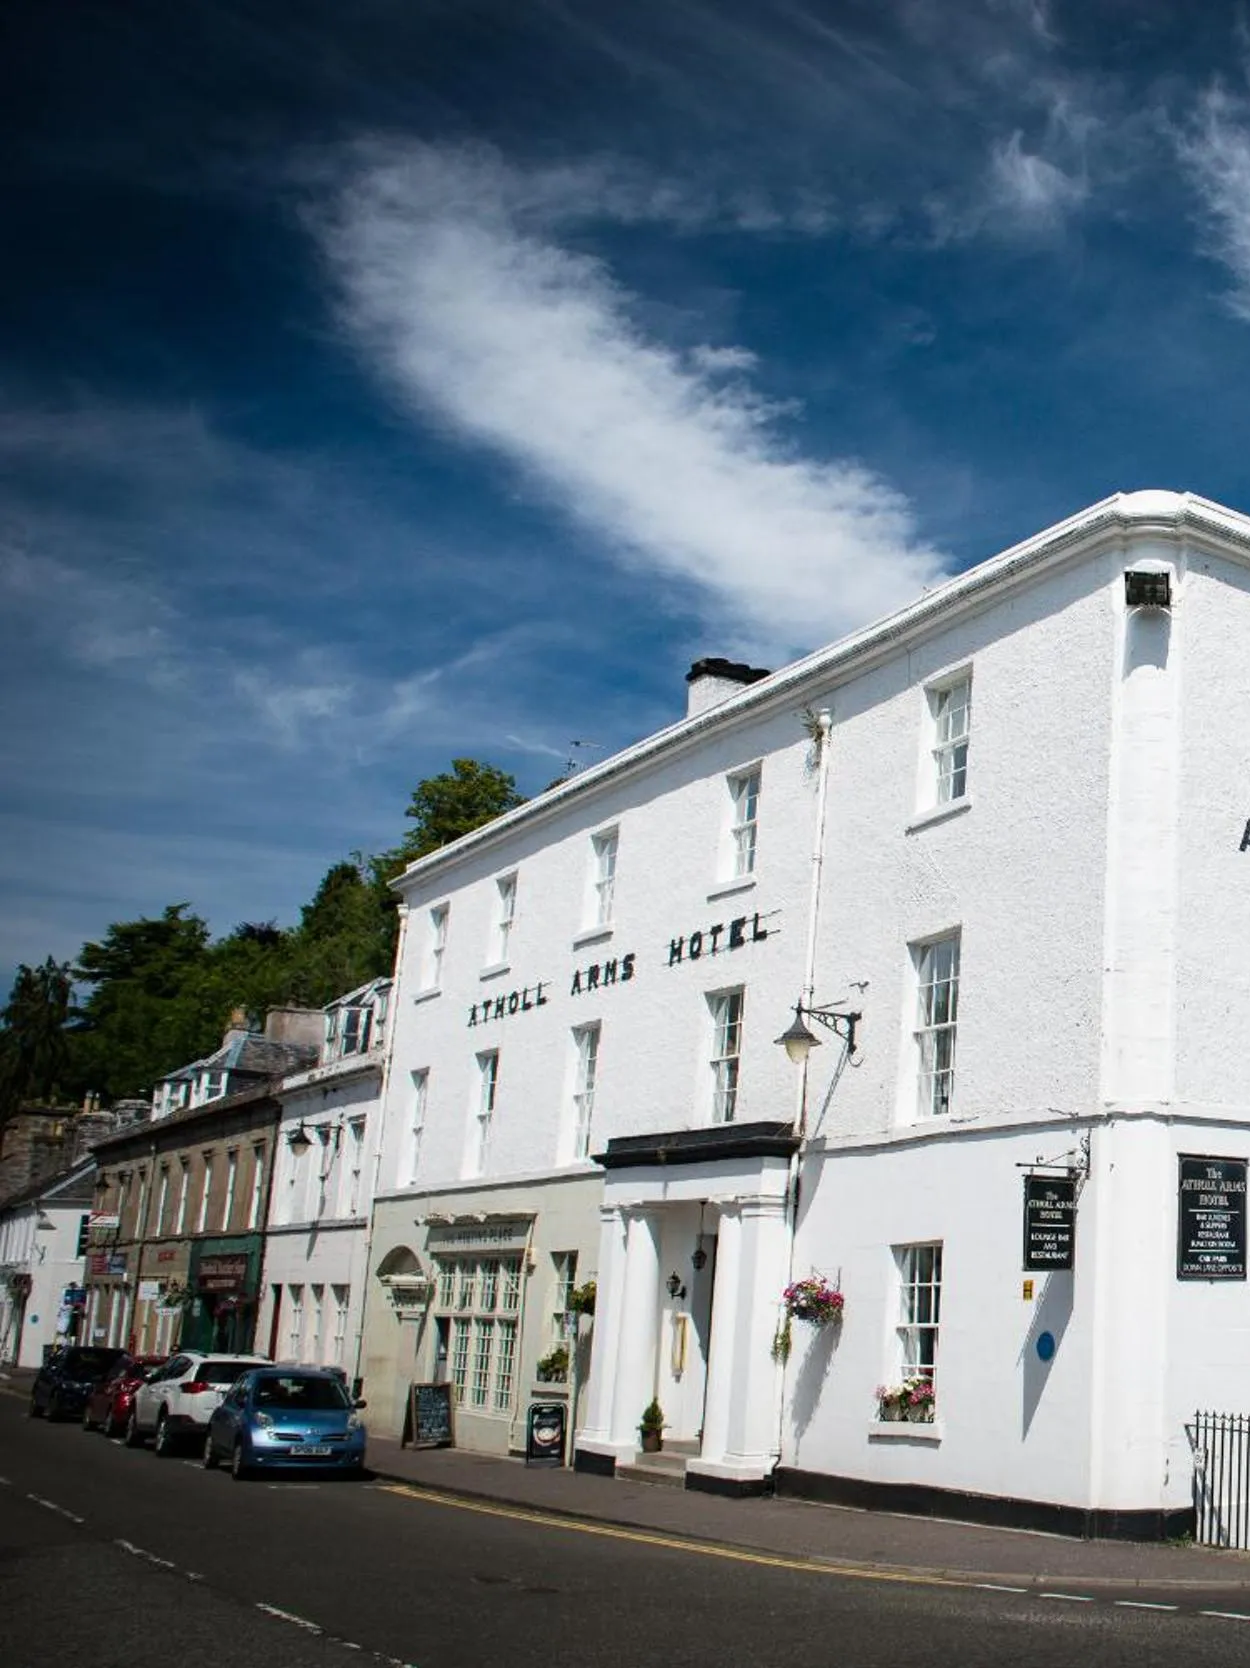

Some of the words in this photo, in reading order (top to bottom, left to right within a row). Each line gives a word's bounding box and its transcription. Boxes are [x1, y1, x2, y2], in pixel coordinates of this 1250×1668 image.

[467, 982, 548, 1027] ATHOLL
[571, 953, 635, 996] ARMS
[669, 912, 767, 967] HOTEL
[1206, 1167, 1222, 1179] The
[1199, 1195, 1229, 1206] HOTEL
